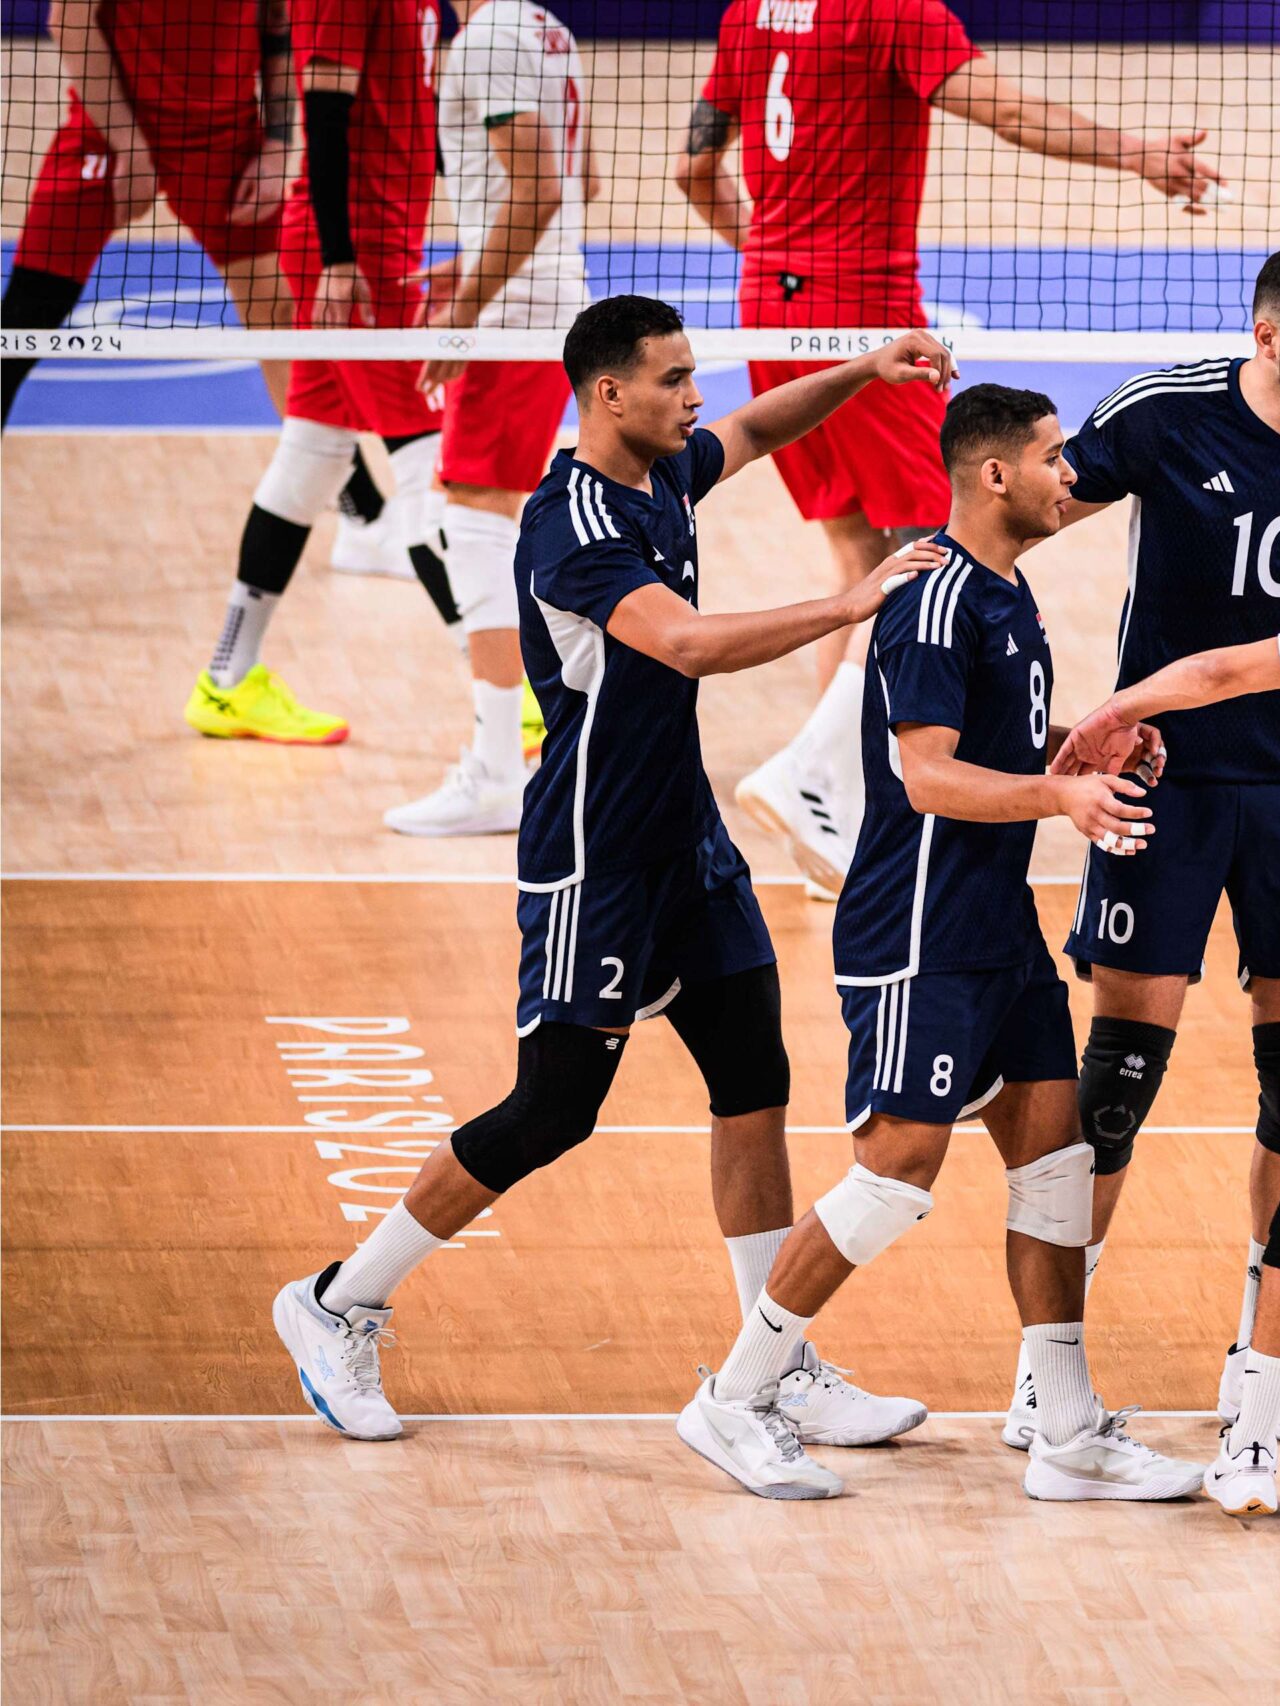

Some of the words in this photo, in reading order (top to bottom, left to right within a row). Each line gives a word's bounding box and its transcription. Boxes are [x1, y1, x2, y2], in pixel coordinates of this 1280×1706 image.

[765, 51, 795, 162] 6
[1029, 660, 1047, 749] 8
[1097, 898, 1135, 944] 10
[598, 956, 625, 1000] 2
[929, 1053, 954, 1098] 8
